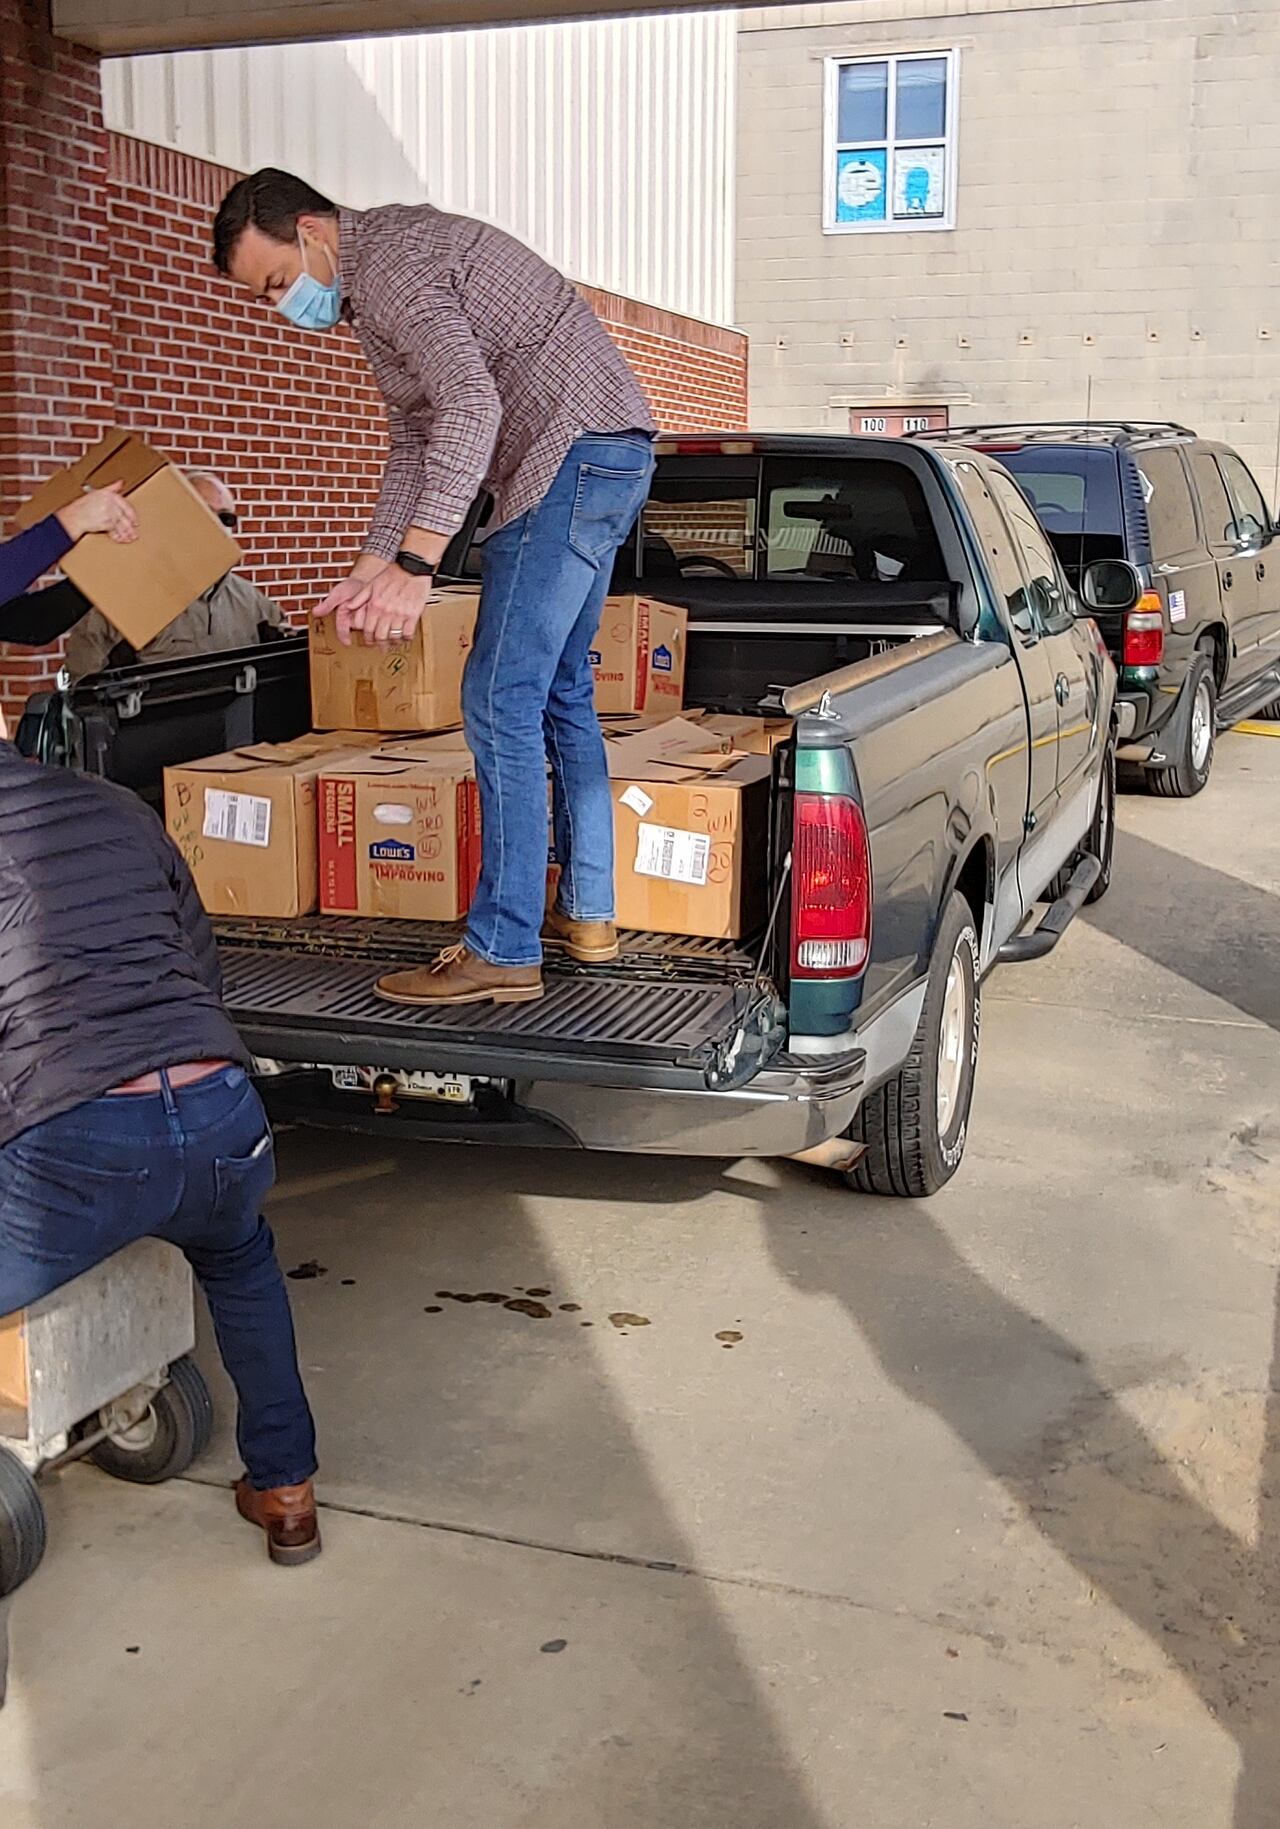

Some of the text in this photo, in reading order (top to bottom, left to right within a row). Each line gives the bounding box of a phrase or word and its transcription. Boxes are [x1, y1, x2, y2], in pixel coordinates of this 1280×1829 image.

[863, 418, 928, 432] 100 110
[336, 782, 354, 848] SMALL
[375, 866, 446, 883] IMPROVING
